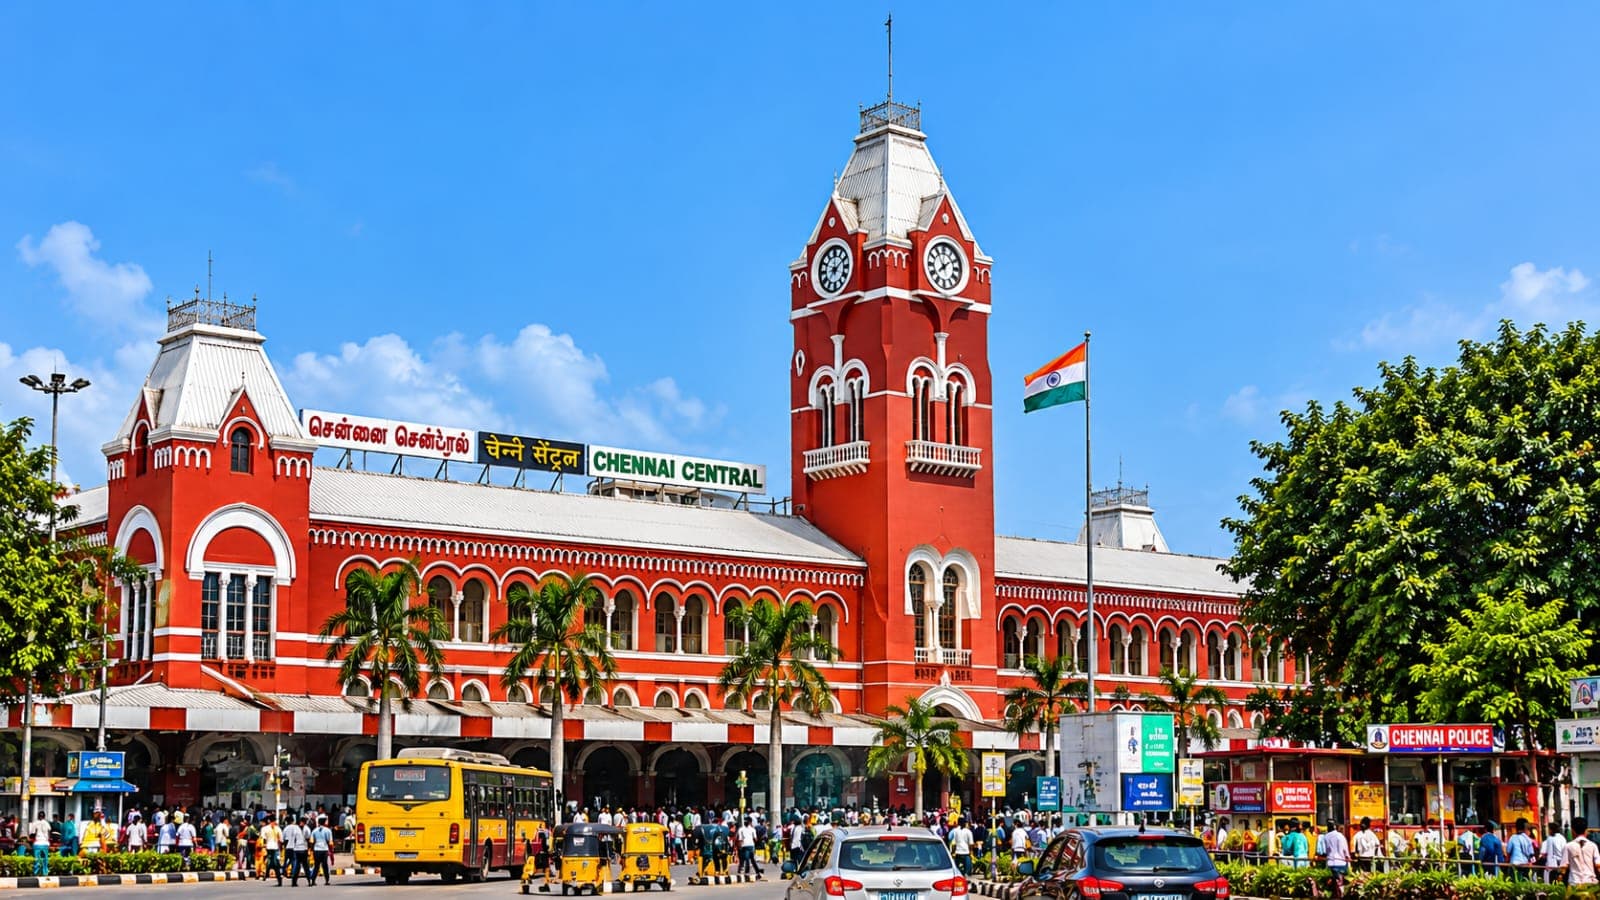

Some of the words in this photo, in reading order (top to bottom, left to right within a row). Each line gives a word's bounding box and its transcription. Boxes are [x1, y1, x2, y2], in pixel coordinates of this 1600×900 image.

[593, 451, 675, 478] CHENNAI
[682, 461, 763, 488] CENTRAL
[1392, 729, 1444, 746] CHENNAI
[1448, 729, 1490, 746] POLICE
